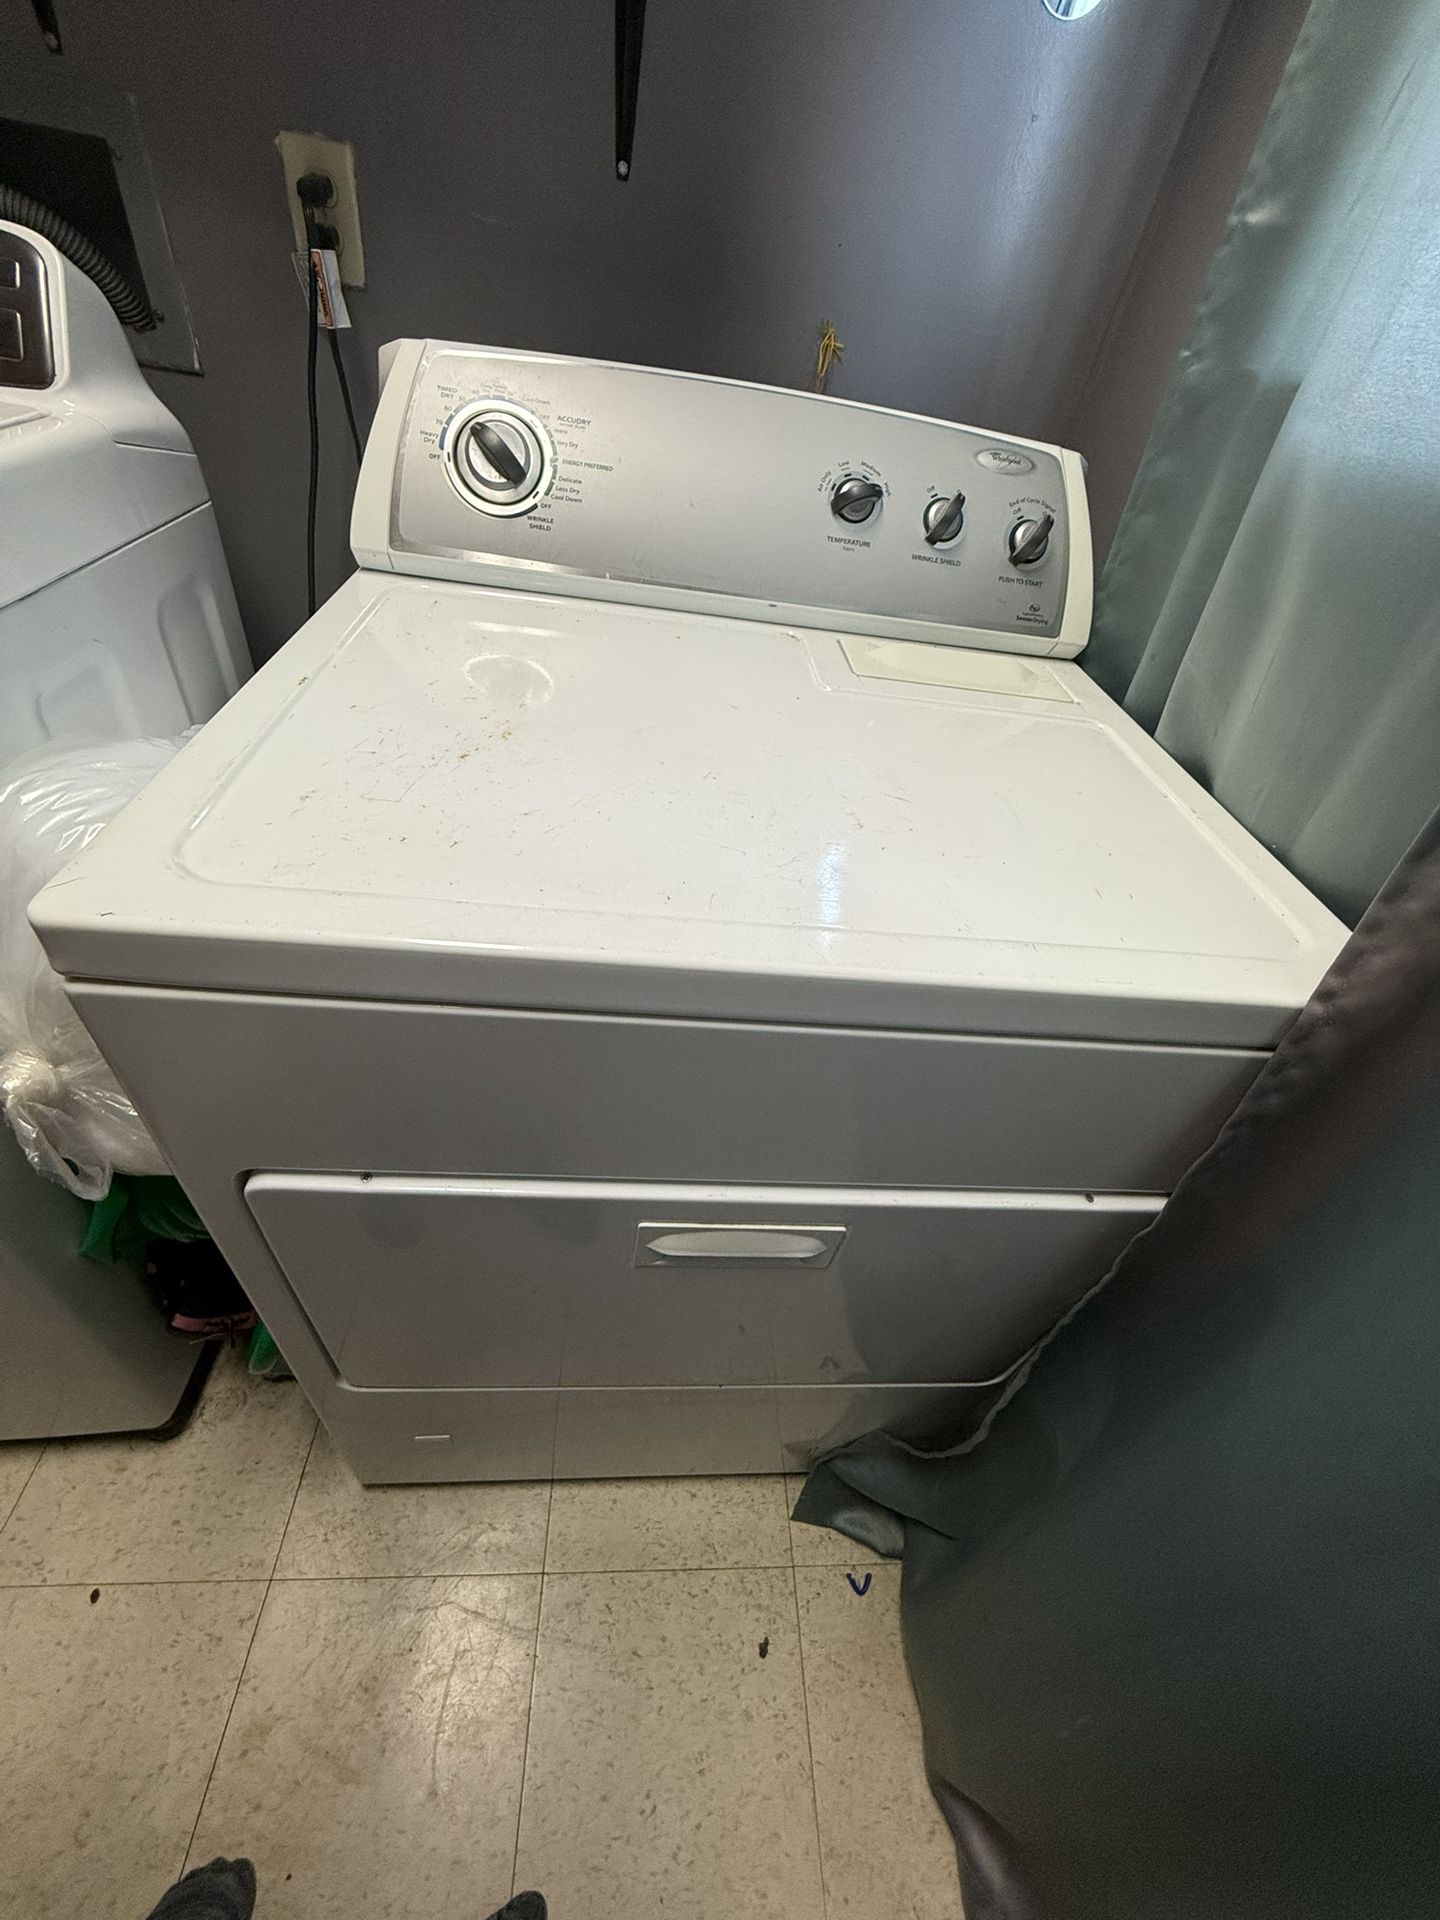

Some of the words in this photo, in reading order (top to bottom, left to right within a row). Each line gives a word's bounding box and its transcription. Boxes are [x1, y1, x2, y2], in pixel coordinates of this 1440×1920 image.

[557, 414, 592, 426] ACCUDRY
[420, 430, 439, 439] Heavy
[423, 436, 435, 445] Dry
[569, 441, 579, 449] Dry
[561, 459, 583, 468] ENERGY
[583, 461, 615, 473] PREFERRED
[558, 475, 583, 484] Delicate
[555, 485, 569, 493] Less
[569, 486, 580, 495] Dry
[550, 493, 564, 501] Cool
[564, 495, 583, 503] Down
[1008, 498, 1020, 508] End
[1026, 496, 1040, 504] Cycle
[1041, 500, 1057, 514] Signal
[526, 515, 554, 524] WRINKLE
[529, 523, 552, 532] SHIELD
[826, 535, 871, 548] TEMPERATURE
[911, 554, 939, 564] WRINKLE
[939, 558, 961, 567] SHIELD
[998, 575, 1015, 584] PUSH
[1015, 577, 1024, 585] TO
[1024, 579, 1043, 588] START
